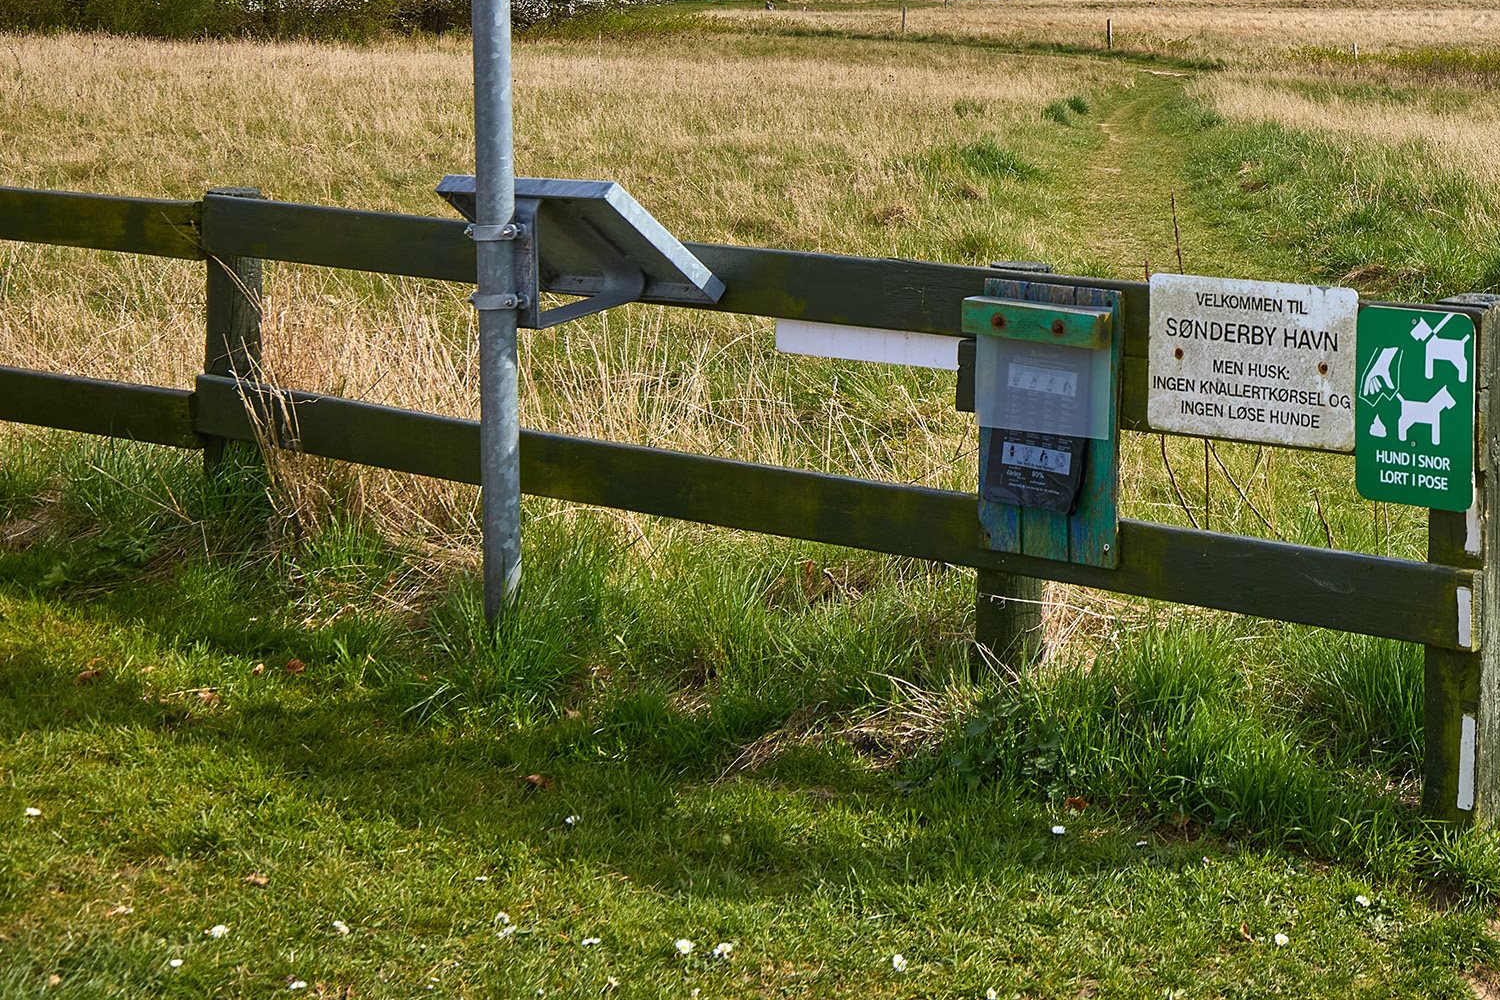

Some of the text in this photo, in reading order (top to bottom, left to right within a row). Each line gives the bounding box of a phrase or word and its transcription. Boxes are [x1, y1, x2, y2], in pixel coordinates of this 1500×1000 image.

[1196, 292, 1308, 315] VELKOMMEN TIL
[1165, 317, 1338, 352] SØNDERBY HAVN
[1212, 359, 1290, 380] MEN HUSK:
[1153, 375, 1351, 409] INGEN KNALLERTKØRSEL OG
[1180, 400, 1320, 429] INGEN LØSE HUNDE
[1376, 449, 1451, 471] HUND I SNOR
[1380, 469, 1449, 491] LORT I POSE
